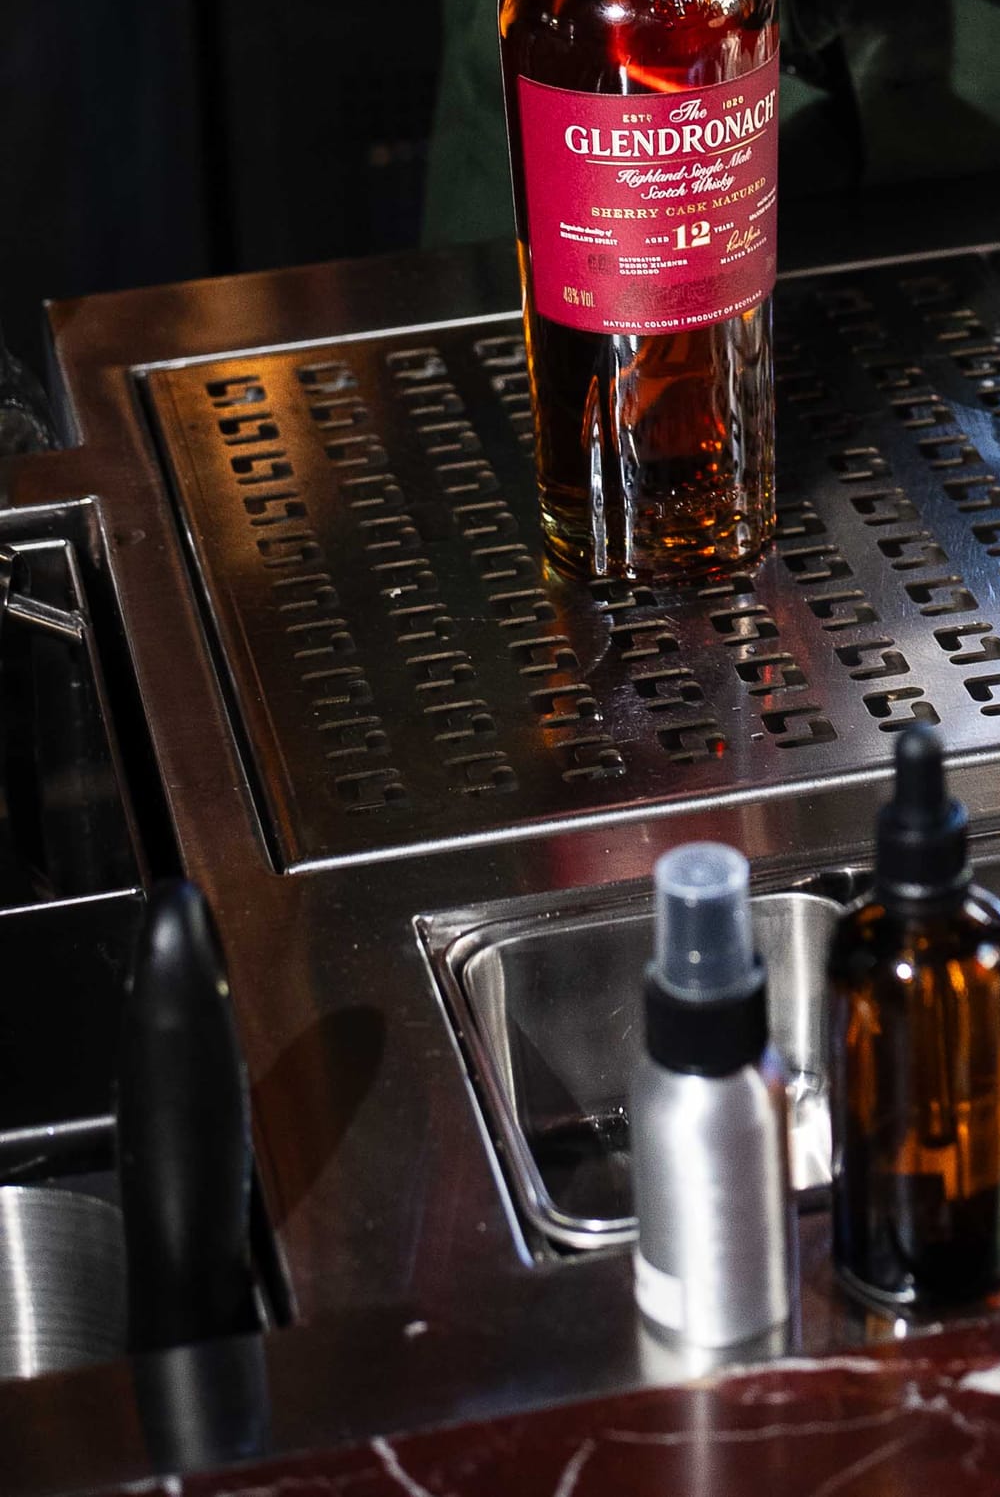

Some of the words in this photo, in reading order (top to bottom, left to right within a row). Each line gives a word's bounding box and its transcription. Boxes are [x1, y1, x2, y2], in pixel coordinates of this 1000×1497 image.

[564, 89, 776, 158] GLENDRONACH
[669, 99, 707, 123] The
[615, 169, 685, 188] Highland
[685, 158, 723, 181] Single
[725, 146, 753, 169] Malt
[591, 207, 659, 219] SHERRY
[666, 202, 707, 216] CASK
[712, 177, 766, 209] MATURED
[640, 184, 688, 201] Scotch
[691, 175, 736, 194] Whisky
[560, 231, 593, 243] HIGHLAND
[595, 237, 618, 246] SPIRIT
[645, 236, 669, 244] AGED
[672, 220, 711, 251] 12
[713, 222, 734, 234] YEARS
[720, 250, 746, 265] MASTER
[563, 286, 579, 305] 43%
[602, 319, 642, 329] NATURAL
[644, 319, 679, 328] COLOUR
[686, 309, 722, 324] PRODUCT
[723, 305, 734, 315] OF
[735, 290, 763, 311] SCOTLAND
